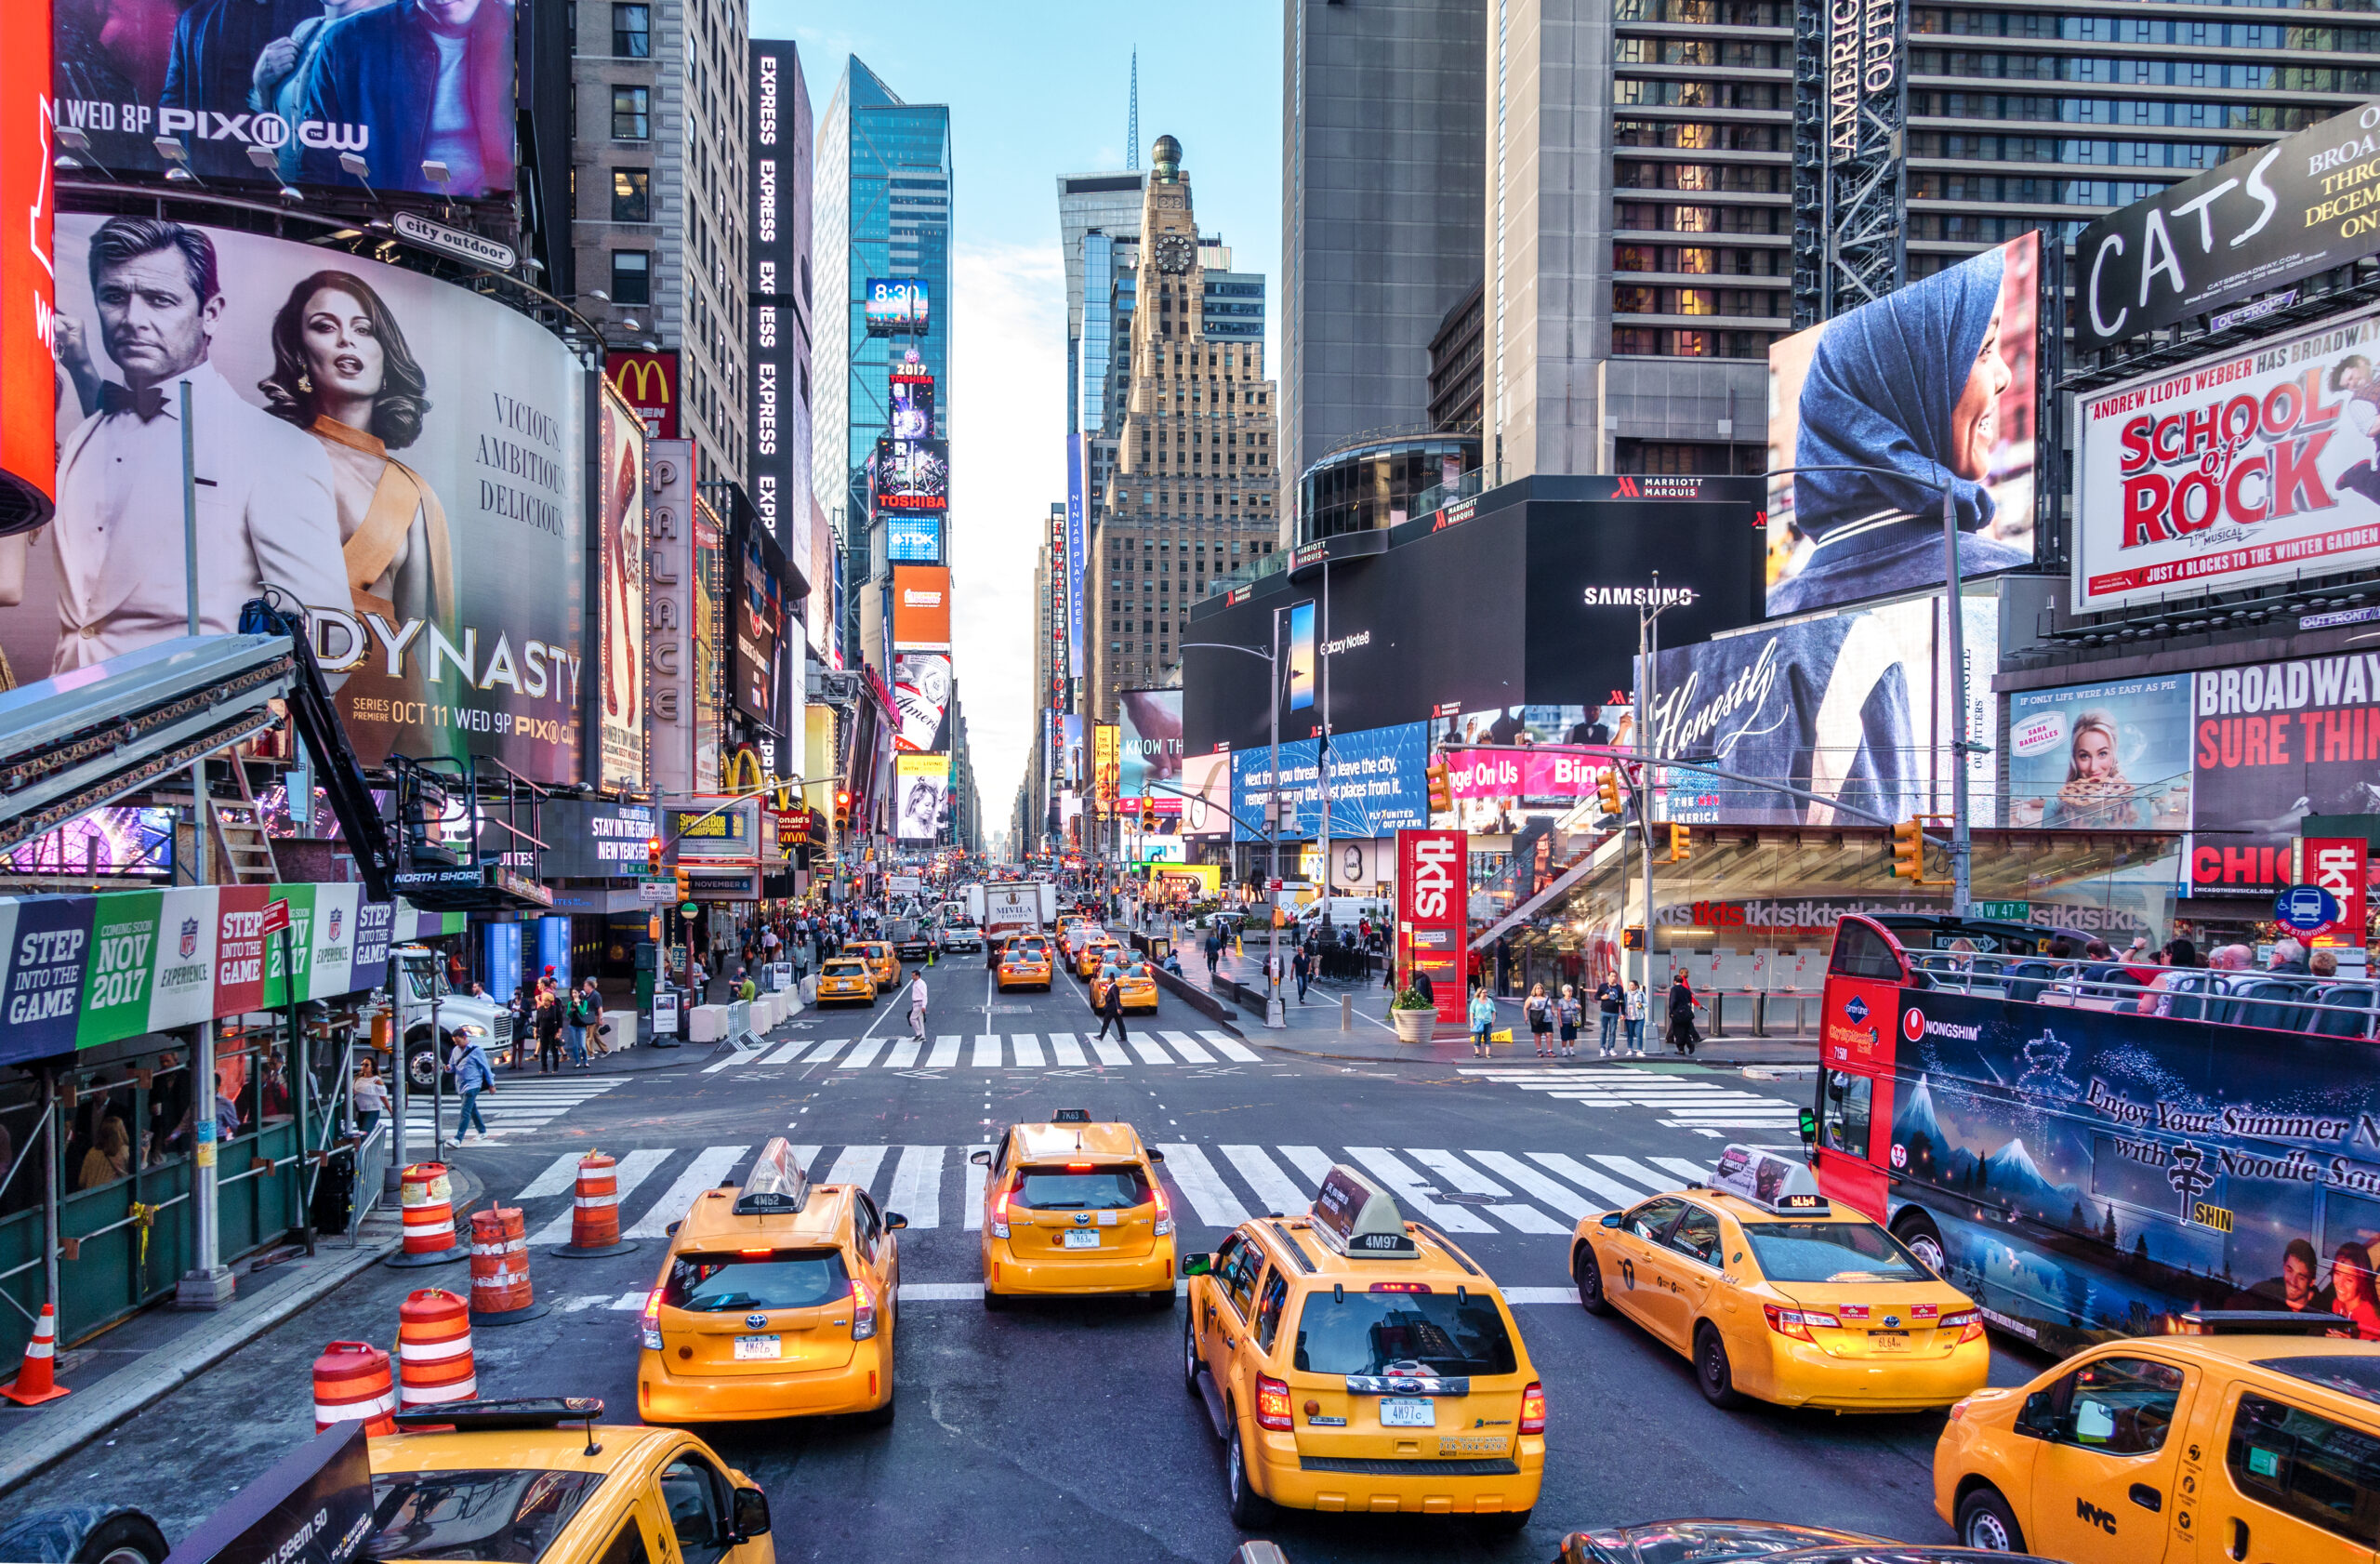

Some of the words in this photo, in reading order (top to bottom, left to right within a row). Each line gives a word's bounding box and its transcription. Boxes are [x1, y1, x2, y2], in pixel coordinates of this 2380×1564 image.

[760, 56, 776, 146] EXPRESS
[68, 100, 114, 131] WED
[122, 104, 152, 133] 8P
[760, 159, 776, 243] EXPRESS
[406, 219, 440, 241] city
[443, 232, 507, 261] outdoor
[2090, 146, 2281, 338] CATS
[2206, 252, 2301, 291] CATSBROADWAY.COM
[874, 283, 919, 303] 8:30
[890, 375, 933, 384] TOSHIBA
[897, 364, 928, 376] 2017
[2149, 376, 2191, 405] LLOYD
[2195, 358, 2254, 391] WEBBER
[2256, 347, 2287, 375] HAS
[759, 364, 776, 456] EXPRESS
[2120, 365, 2344, 473] SCHOOL
[2200, 434, 2243, 484] of
[1645, 478, 1703, 486] MARRIOTT
[1645, 488, 1696, 497] MARQUIS
[2120, 429, 2338, 550] ROCK
[878, 495, 947, 509] TOSHIBA
[1448, 497, 1477, 515] MARRIOTT
[1071, 494, 1079, 545] NINJAS
[1448, 509, 1474, 524] MARQUIS
[902, 533, 935, 545] TDK
[1297, 540, 1327, 556] MARRIOTT
[2194, 531, 2207, 541] THE
[2202, 528, 2243, 546] MUSICAL
[1297, 550, 1323, 564] MARQUIS
[2147, 565, 2174, 584] JUST
[2176, 564, 2184, 578] 4
[2186, 559, 2229, 577] BLOCKS
[2231, 551, 2248, 568] TO
[2249, 547, 2273, 563] THE
[2275, 537, 2323, 561] WINTER
[2326, 527, 2379, 554] GARDEN
[653, 460, 678, 721] PALACE
[1235, 584, 1253, 596] MARRIOTT
[1583, 587, 1692, 606] SAMSUNG
[1320, 639, 1346, 656] Galaxy
[1346, 630, 1370, 649] Note8
[307, 605, 582, 710] DYNASTY
[2020, 696, 2029, 706] IF
[2030, 695, 2054, 705] ONLY
[2055, 692, 2074, 702] LIFE
[2076, 689, 2101, 699] WERE
[2104, 688, 2116, 697] AS
[2119, 684, 2143, 696] EASY
[2145, 683, 2159, 693] AS
[2161, 681, 2177, 691] PIE
[2198, 651, 2380, 717] BROADWAY
[1649, 636, 1788, 759] Honestly
[353, 696, 390, 712] SERIES
[392, 699, 428, 725] OCT
[431, 704, 449, 727] 11
[454, 706, 490, 733] WED
[495, 711, 512, 735] 9P
[353, 710, 390, 722] PREMIERE
[2018, 729, 2058, 748] BAREILLES
[2028, 724, 2047, 736] SARA
[2198, 713, 2291, 770] SURE
[1126, 738, 1162, 755] KNOW
[1245, 773, 1261, 788] Next
[1279, 771, 1294, 786] you
[1337, 762, 1360, 777] leave
[1361, 760, 1376, 775] the
[1377, 755, 1397, 775] city,
[1475, 762, 1493, 787] On
[1499, 760, 1519, 785] Us
[1305, 787, 1318, 802] the
[1341, 783, 1368, 801] places
[1368, 780, 1390, 796] from
[1673, 797, 1695, 807] THE
[1369, 812, 1382, 820] FLY
[1386, 809, 1414, 819] UNITED
[1382, 820, 1396, 828] OUT
[1408, 819, 1422, 828] EWR
[592, 817, 614, 837] STAY
[615, 818, 623, 838] IN
[599, 841, 613, 860] NEW
[394, 871, 436, 883] NORTH
[440, 869, 483, 881] SHORE
[628, 864, 636, 873] W
[1415, 836, 1457, 919] tkts
[359, 903, 390, 928] STEP
[996, 906, 1032, 915] MIVILA
[1693, 900, 1745, 927] tkts
[1986, 906, 1997, 918] W
[2001, 904, 2015, 917] 47
[2018, 903, 2027, 912] St
[101, 923, 131, 937] COMING
[132, 920, 153, 934] SOON
[221, 910, 264, 940] STEP
[2279, 921, 2291, 931] NO
[2290, 921, 2332, 938] STANDING
[19, 928, 86, 967] STEP
[179, 935, 198, 955] NFL
[358, 931, 376, 945] INTO
[375, 929, 389, 942] THE
[99, 934, 153, 974] NOV
[221, 943, 242, 960] INTO
[243, 941, 261, 957] THE
[316, 946, 349, 964] EXPERIENCE
[356, 943, 387, 966] GAME
[1673, 955, 1677, 966] 1
[1713, 955, 1722, 965] 2
[1756, 955, 1765, 966] 3
[1798, 956, 1806, 965] 4
[15, 970, 54, 991] INTO
[56, 965, 78, 987] THE
[160, 962, 209, 988] EXPERIENCE
[220, 961, 260, 987] GAME
[90, 968, 148, 1012] 2017
[9, 987, 76, 1026] GAME
[1062, 1111, 1079, 1120] 7K63
[2087, 1078, 2153, 1129] Enjoy
[2156, 1101, 2215, 1134] Your
[2220, 1107, 2350, 1141] Summer
[2113, 1136, 2166, 1168] with
[2215, 1147, 2319, 1182] Noodle
[2194, 1202, 2233, 1233] SHIN
[1365, 1235, 1398, 1249] 4M97
[1439, 1442, 1508, 1451] 718-784-9292
[2076, 1496, 2117, 1536] NYC
[279, 1521, 313, 1561] seem
[314, 1507, 328, 1533] so
[331, 1542, 344, 1561] FLY
[346, 1512, 368, 1543] UNITED
